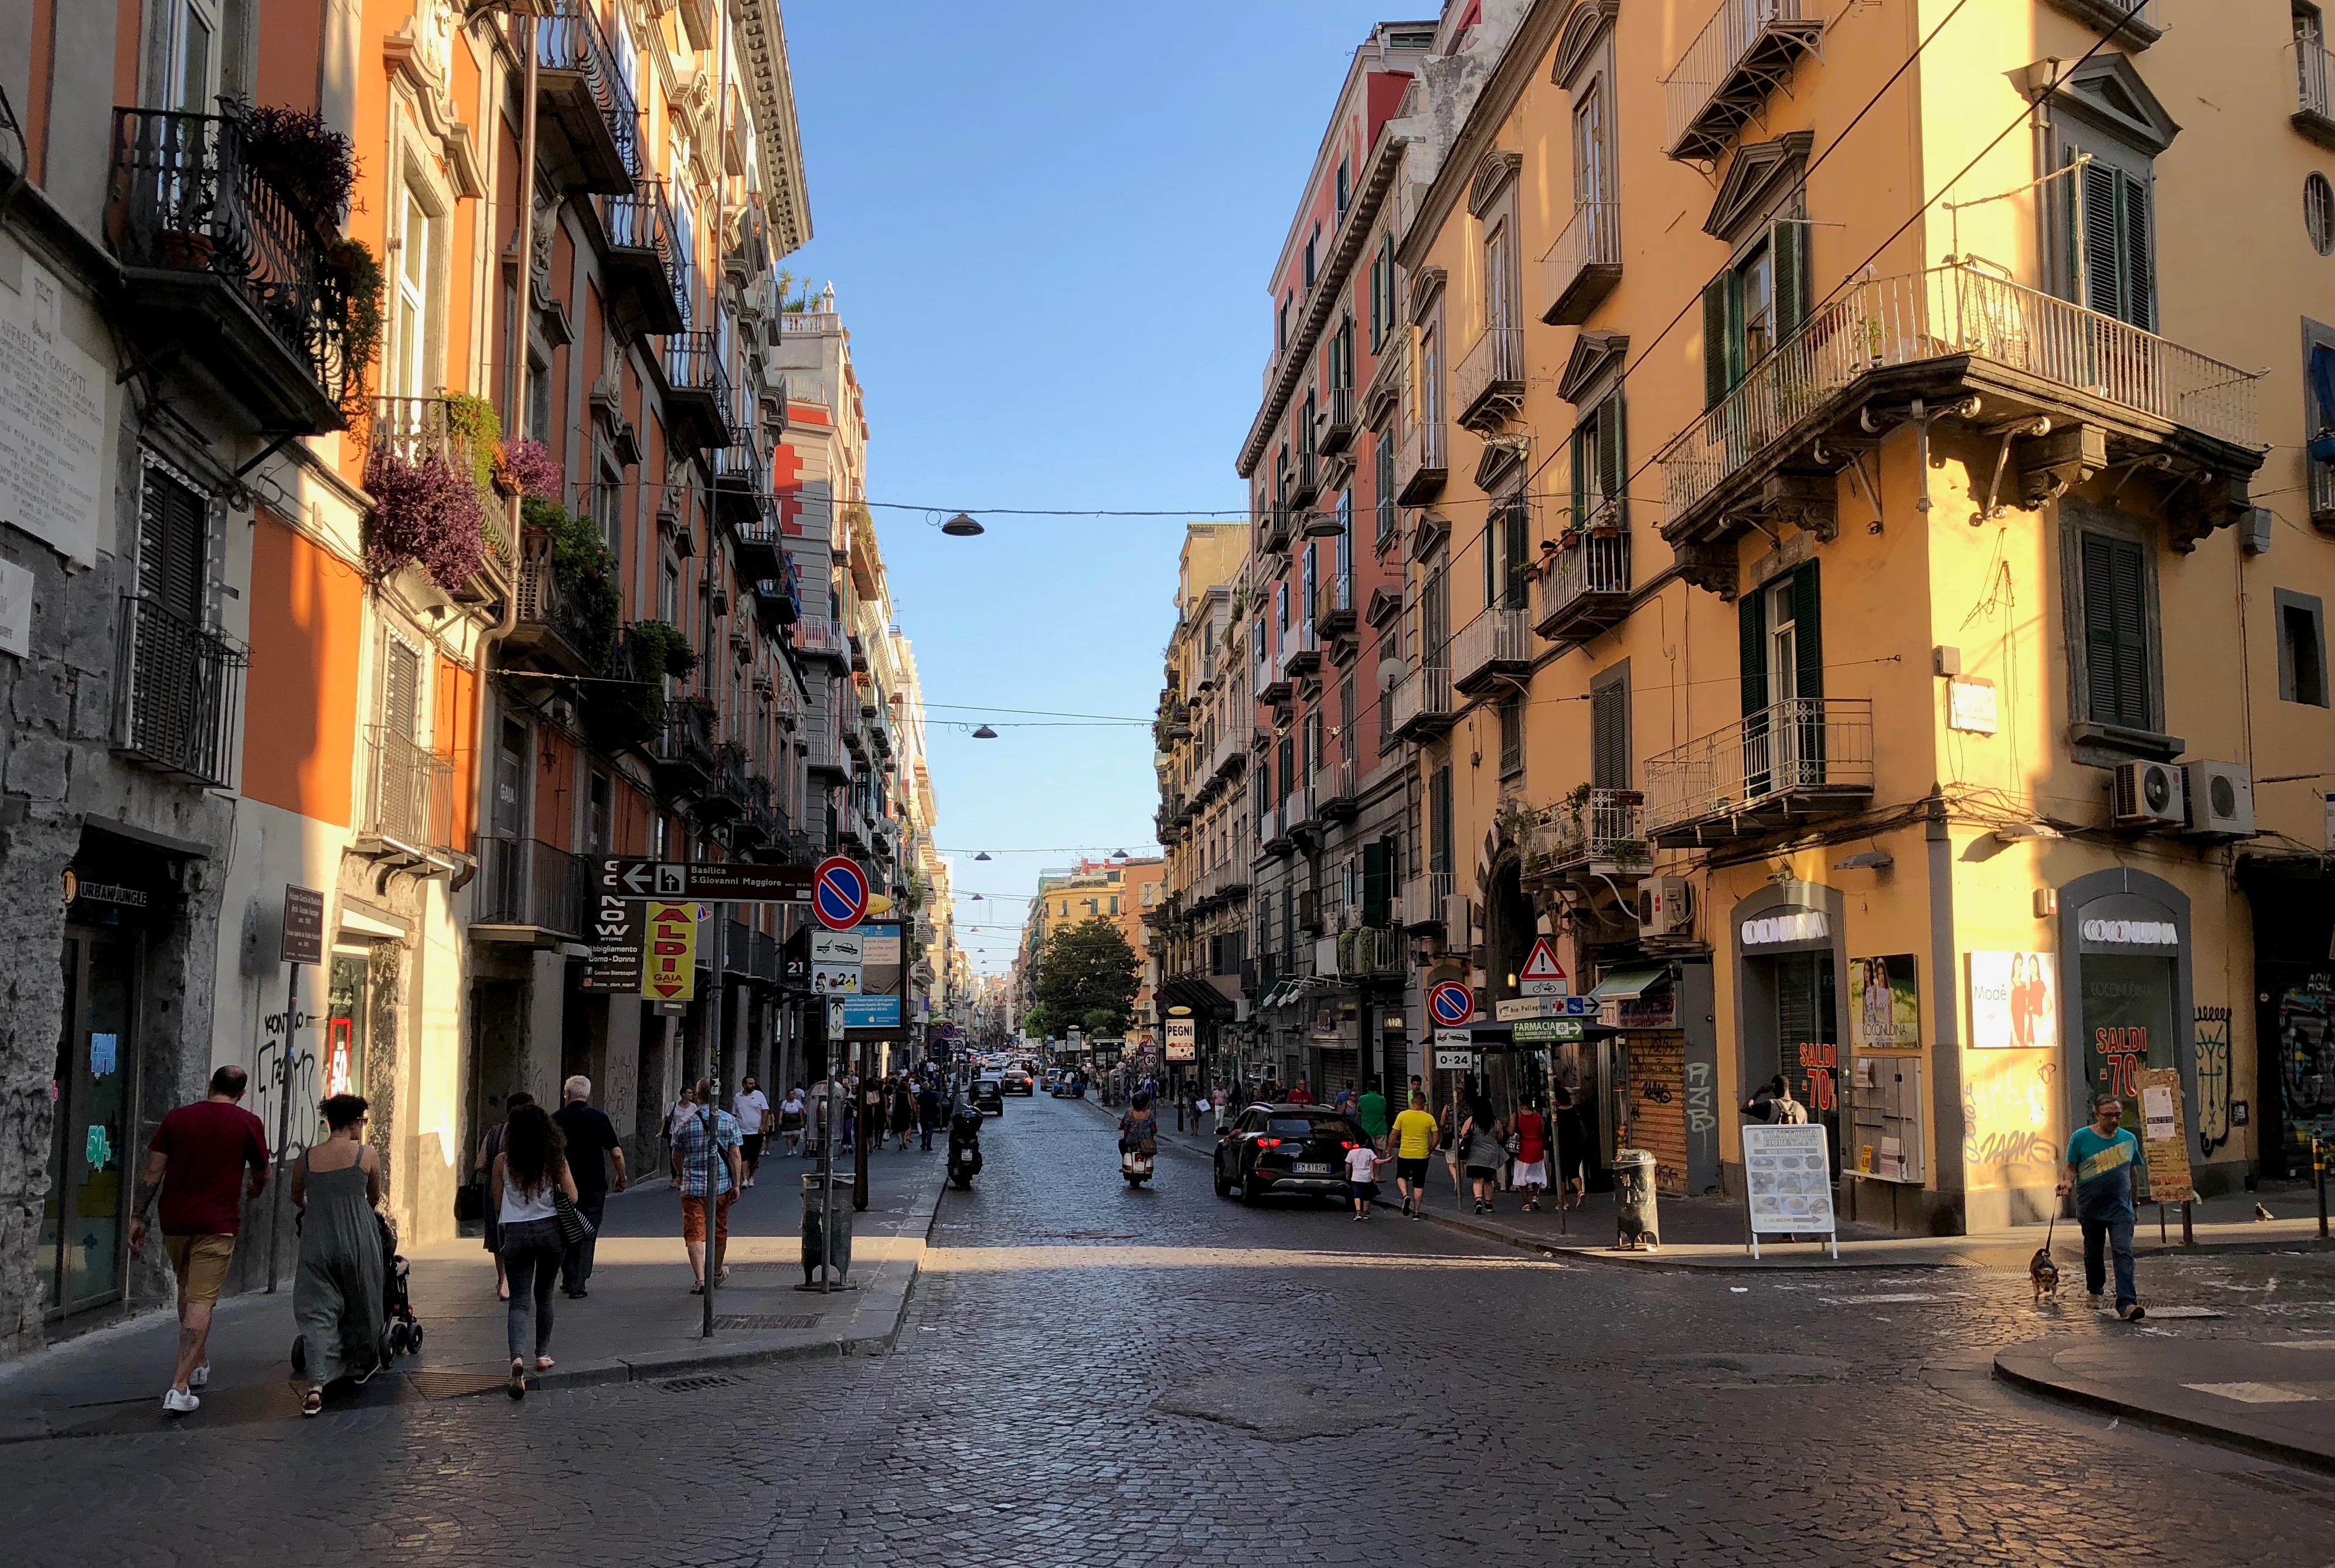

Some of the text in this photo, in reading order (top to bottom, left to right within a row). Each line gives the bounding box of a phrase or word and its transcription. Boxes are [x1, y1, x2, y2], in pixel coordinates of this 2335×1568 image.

[43, 350, 86, 393] CONFORTI
[691, 866, 726, 874] Basilica
[691, 876, 738, 885] S.Giovanni
[743, 878, 782, 887] Maggiore
[81, 882, 115, 903] URBAN
[114, 884, 147, 907] JUNGLE
[651, 901, 693, 973] ALDI
[588, 945, 638, 954] Abbigliamento
[787, 962, 803, 973] 21
[653, 973, 683, 982] GAIA
[1499, 1003, 1548, 1014] Vhio Pellegrini
[1167, 1025, 1193, 1037] PEGNI
[1514, 1021, 1555, 1032] FARMACIA
[1863, 1024, 1907, 1037] COCONUDINA
[2096, 1027, 2147, 1054] SALDI
[1799, 1042, 1837, 1068] SALDI
[2100, 1053, 2146, 1097] -70
[1762, 1129, 1819, 1139] TRATTORIA
[1763, 1138, 1819, 1147] FIORENZANO
